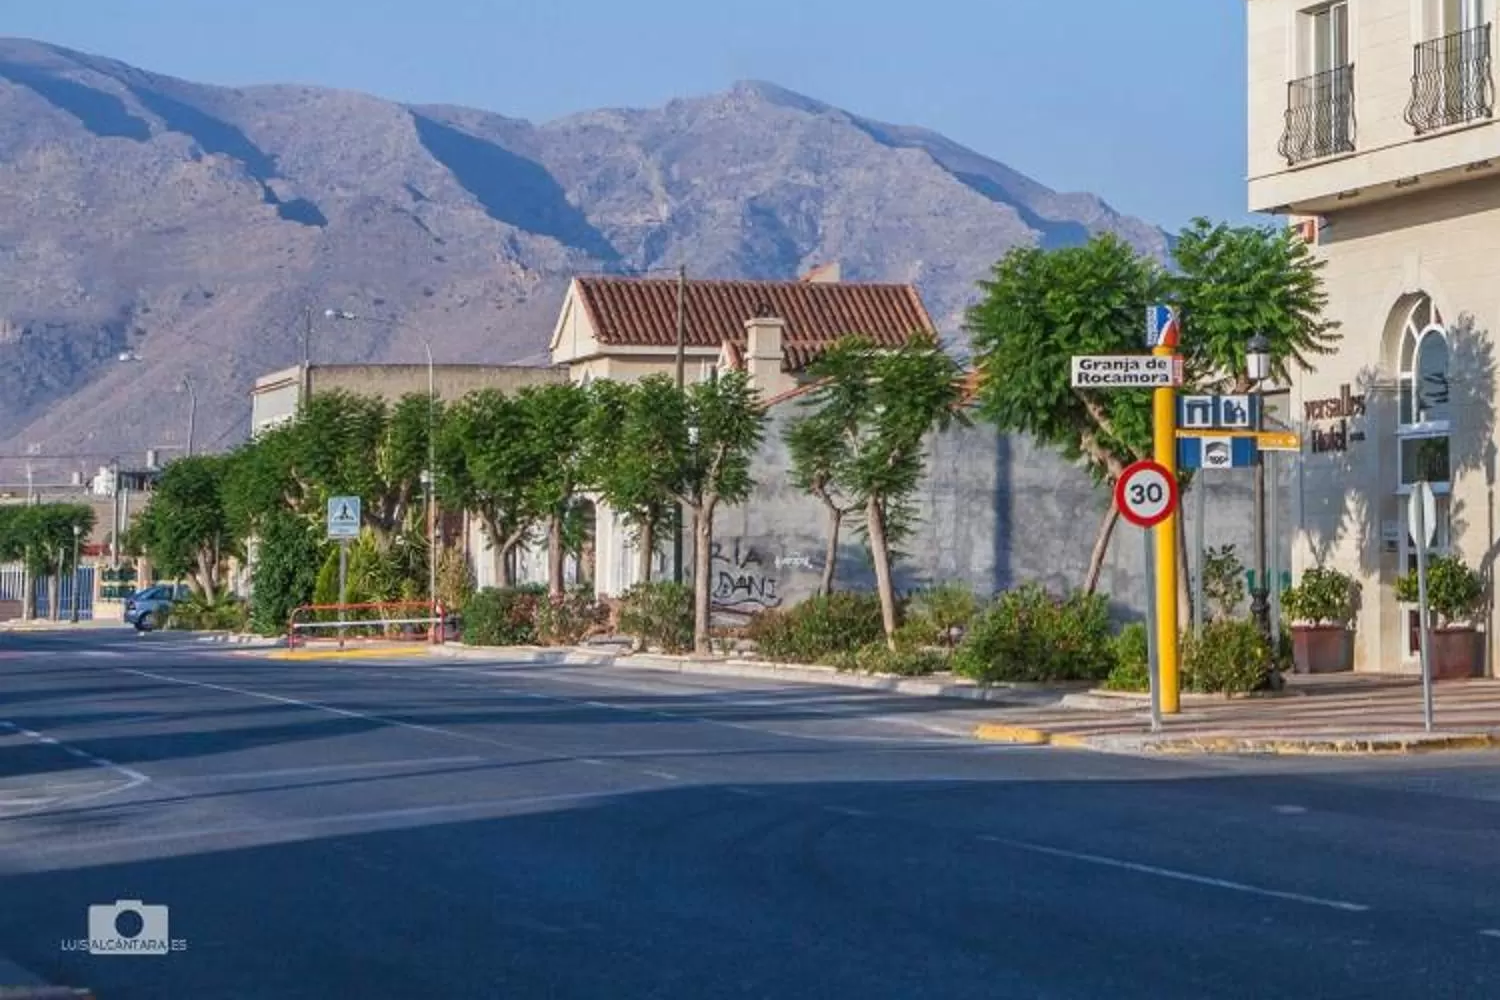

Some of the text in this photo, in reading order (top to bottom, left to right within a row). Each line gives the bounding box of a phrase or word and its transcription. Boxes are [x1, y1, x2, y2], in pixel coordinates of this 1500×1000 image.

[1079, 358, 1168, 373] Granja de
[1077, 372, 1170, 384] Rocamora
[1130, 483, 1163, 505] 30
